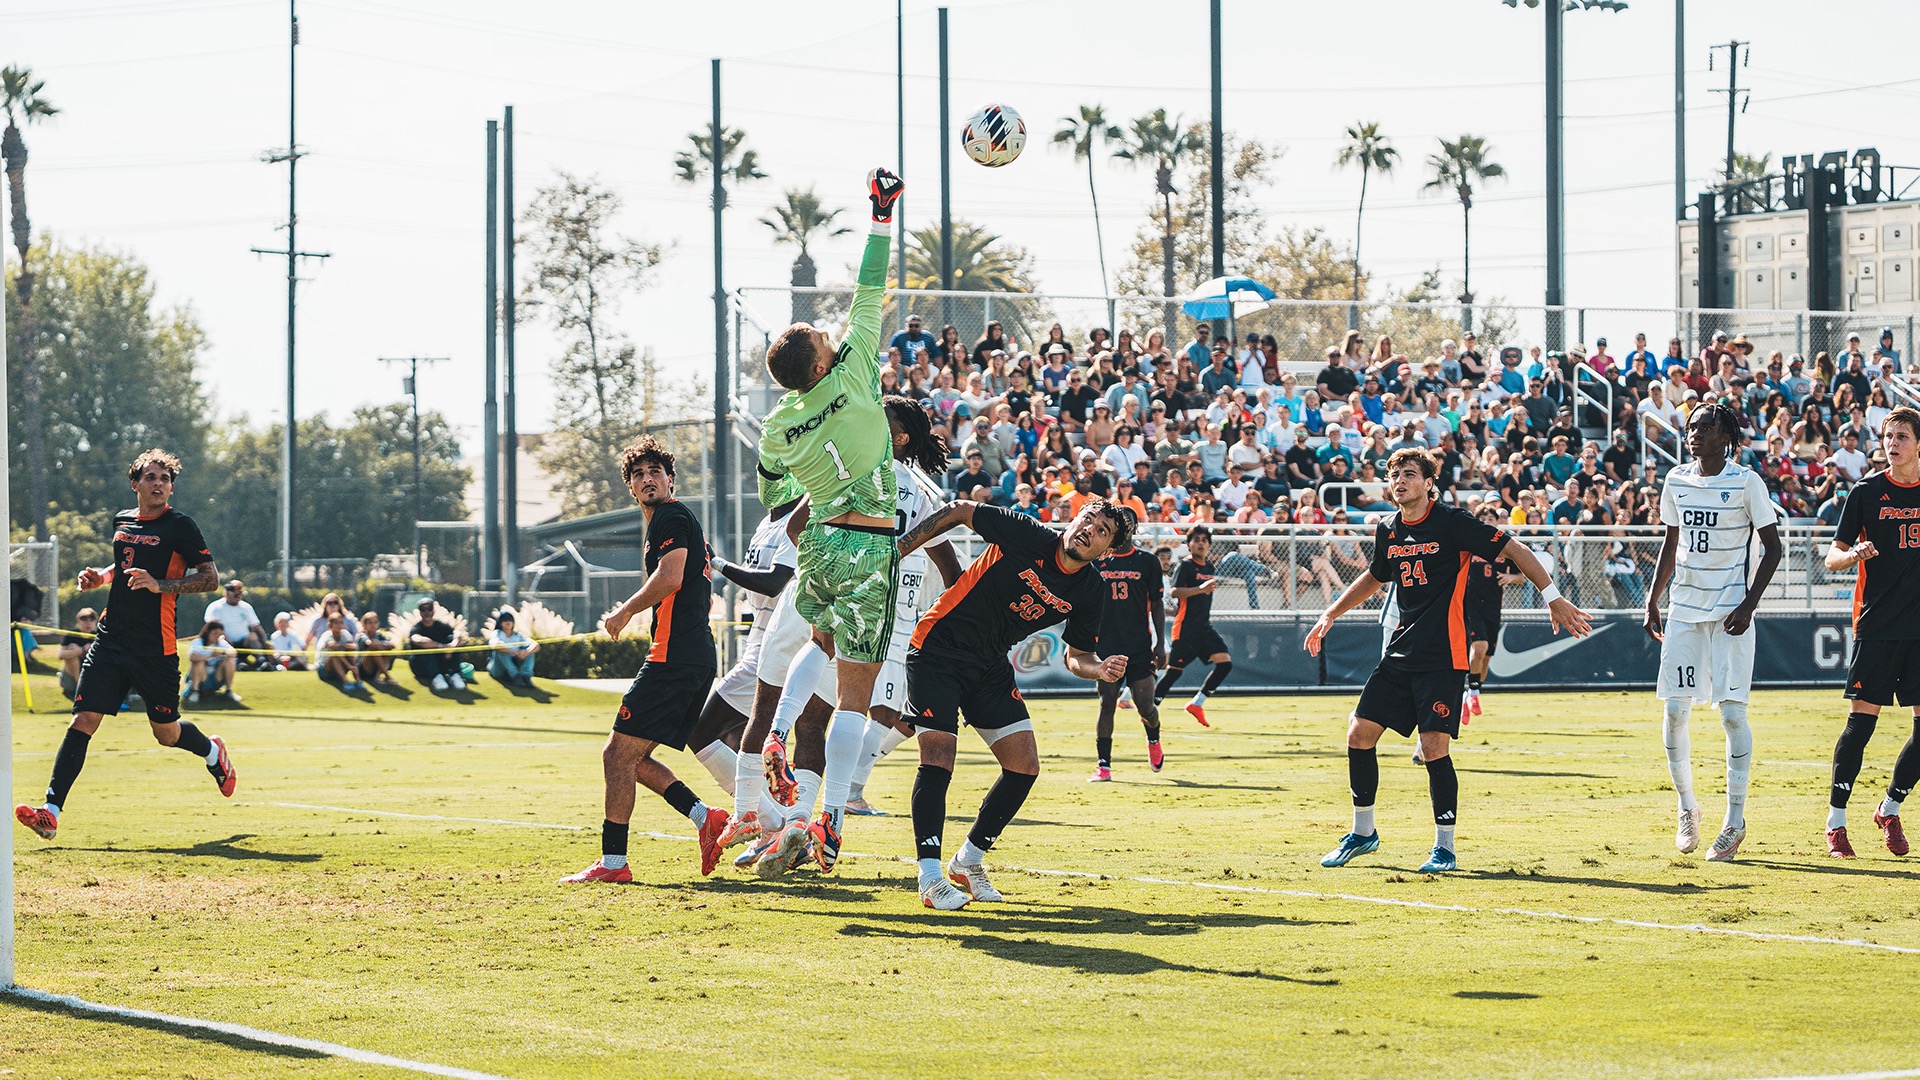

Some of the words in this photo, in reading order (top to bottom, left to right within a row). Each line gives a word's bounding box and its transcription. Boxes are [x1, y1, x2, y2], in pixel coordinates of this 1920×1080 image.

[784, 393, 848, 446] PACIFIC
[823, 439, 852, 481] 1
[1683, 510, 1718, 527] CBU
[1689, 530, 1709, 553] 18
[1898, 523, 1920, 549] 19
[121, 547, 134, 569] 3
[1387, 541, 1440, 559] PACIFIC
[902, 573, 922, 588] CBU
[1399, 560, 1428, 587] 24
[1483, 563, 1493, 578] 6
[907, 589, 915, 608] 8
[1018, 567, 1073, 614] PACIFIC
[1111, 581, 1129, 600] 13
[1008, 593, 1046, 621] 30
[1813, 624, 1854, 670] C
[1677, 665, 1696, 688] 18
[885, 682, 894, 700] 8
